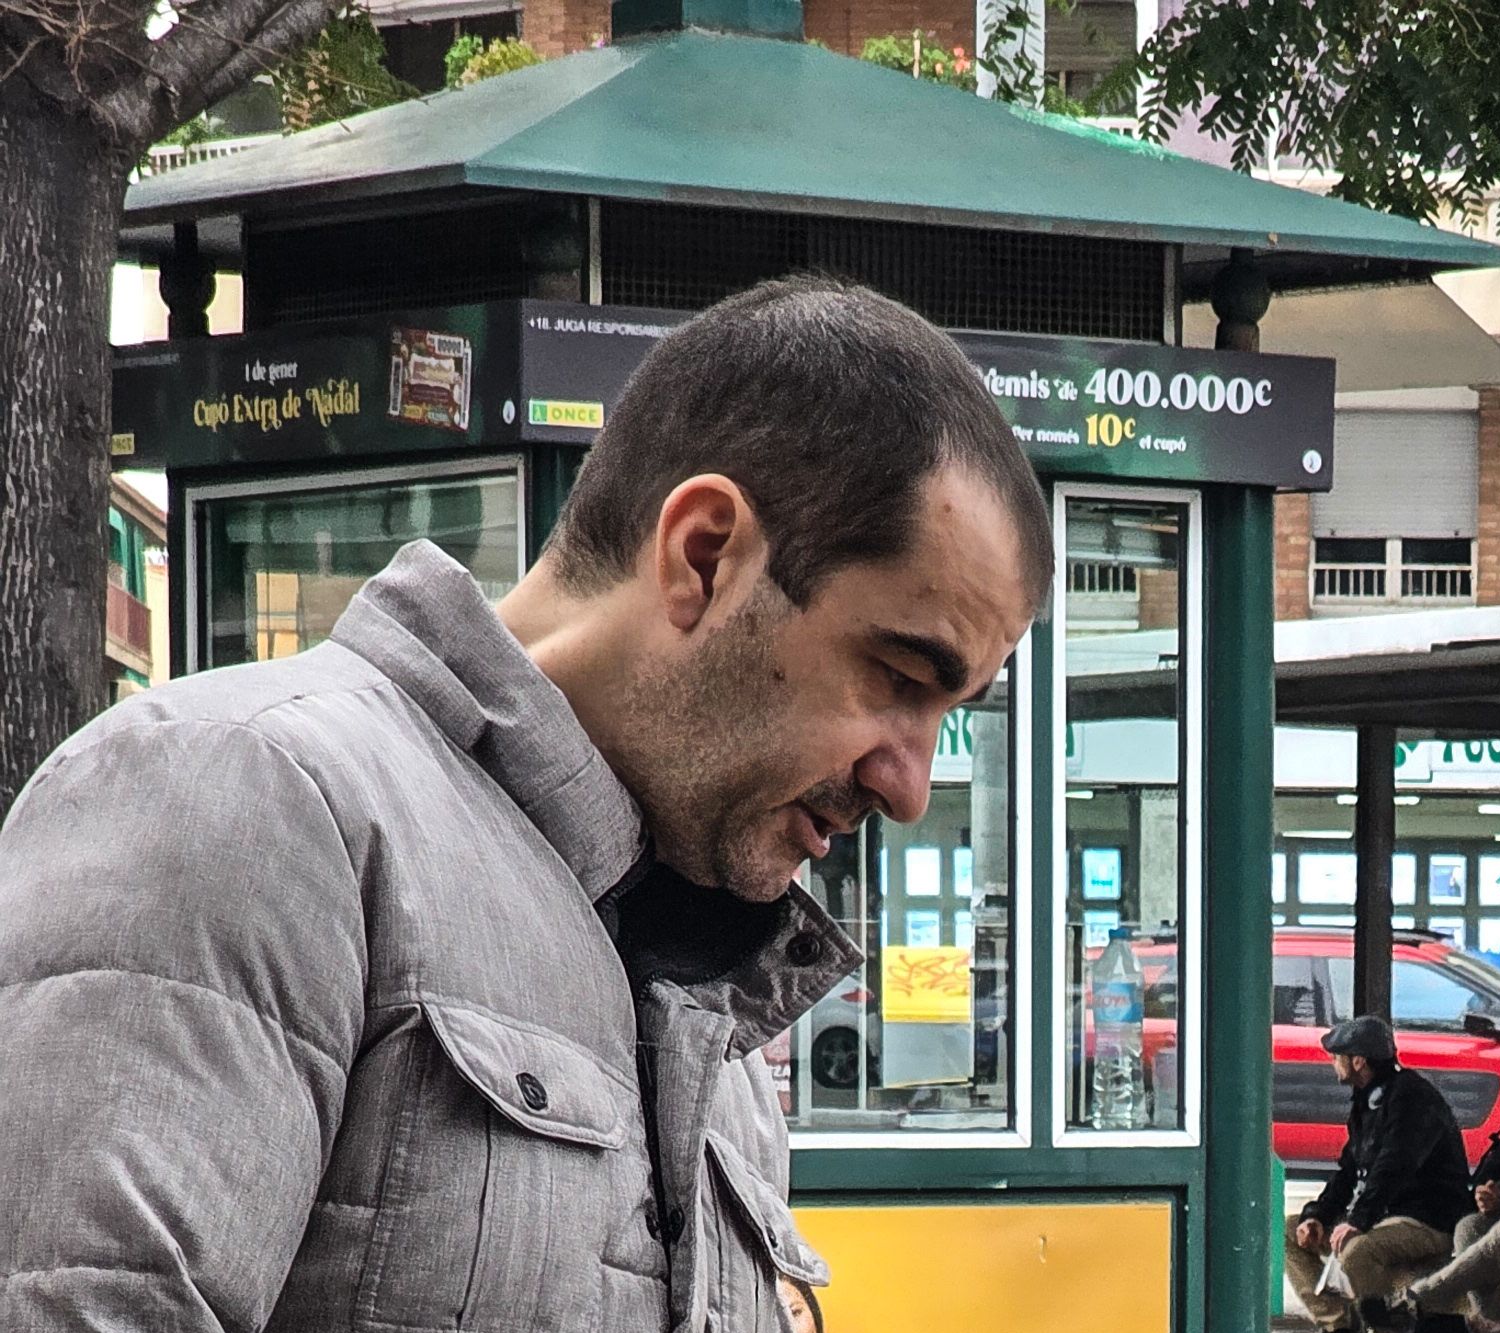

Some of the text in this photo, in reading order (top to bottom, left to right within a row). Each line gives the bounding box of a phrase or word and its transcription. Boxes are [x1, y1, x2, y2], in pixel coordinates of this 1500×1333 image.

[252, 359, 267, 381] de
[268, 362, 298, 387] gener
[233, 393, 282, 432] Extra
[282, 388, 301, 419] de
[305, 378, 360, 428] Nadal
[984, 368, 1050, 399] remis
[1084, 367, 1273, 415] 400.000€
[551, 407, 597, 422] ONCE
[1139, 434, 1151, 450] el
[1153, 435, 1187, 455] cupó
